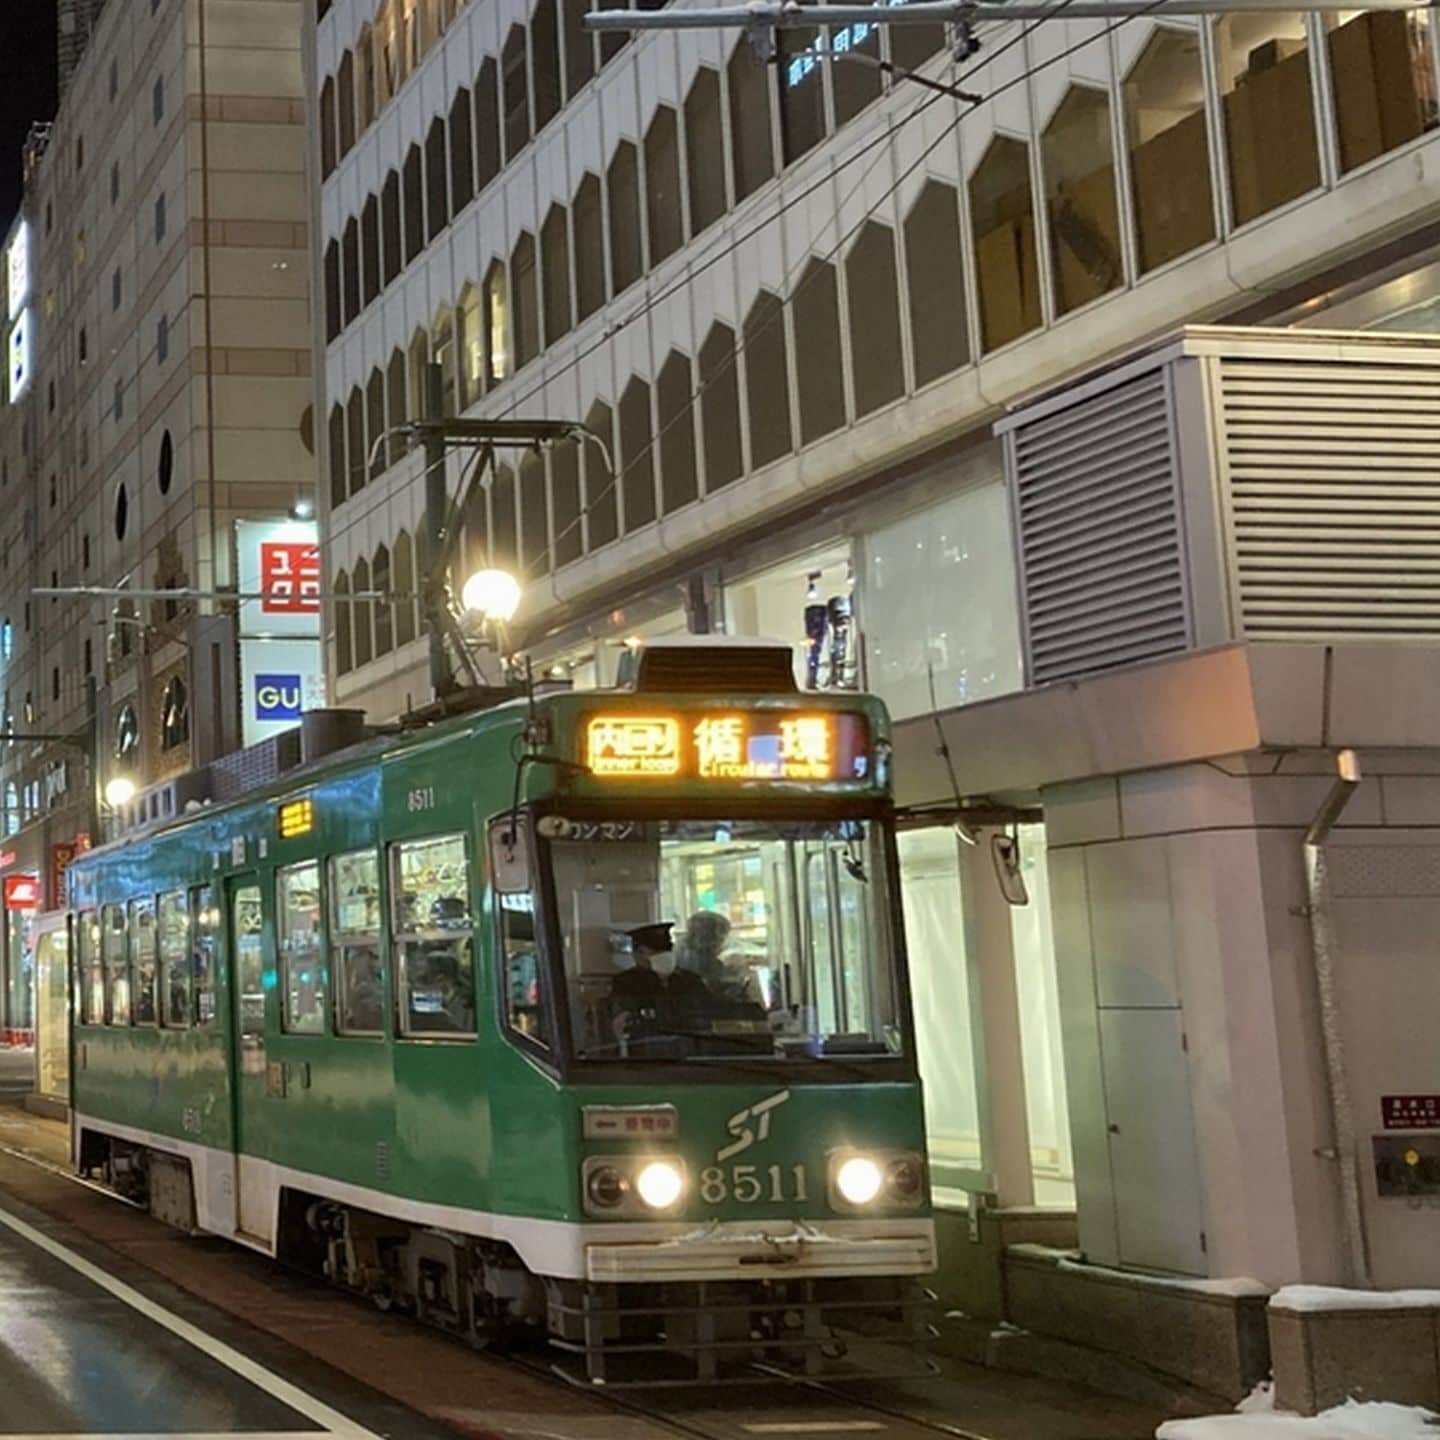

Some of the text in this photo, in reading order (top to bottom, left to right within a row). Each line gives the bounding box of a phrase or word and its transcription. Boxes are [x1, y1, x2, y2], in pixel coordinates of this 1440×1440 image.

[258, 686, 299, 708] GU
[407, 786, 435, 812] 8511
[699, 1165, 808, 1204] 8511
